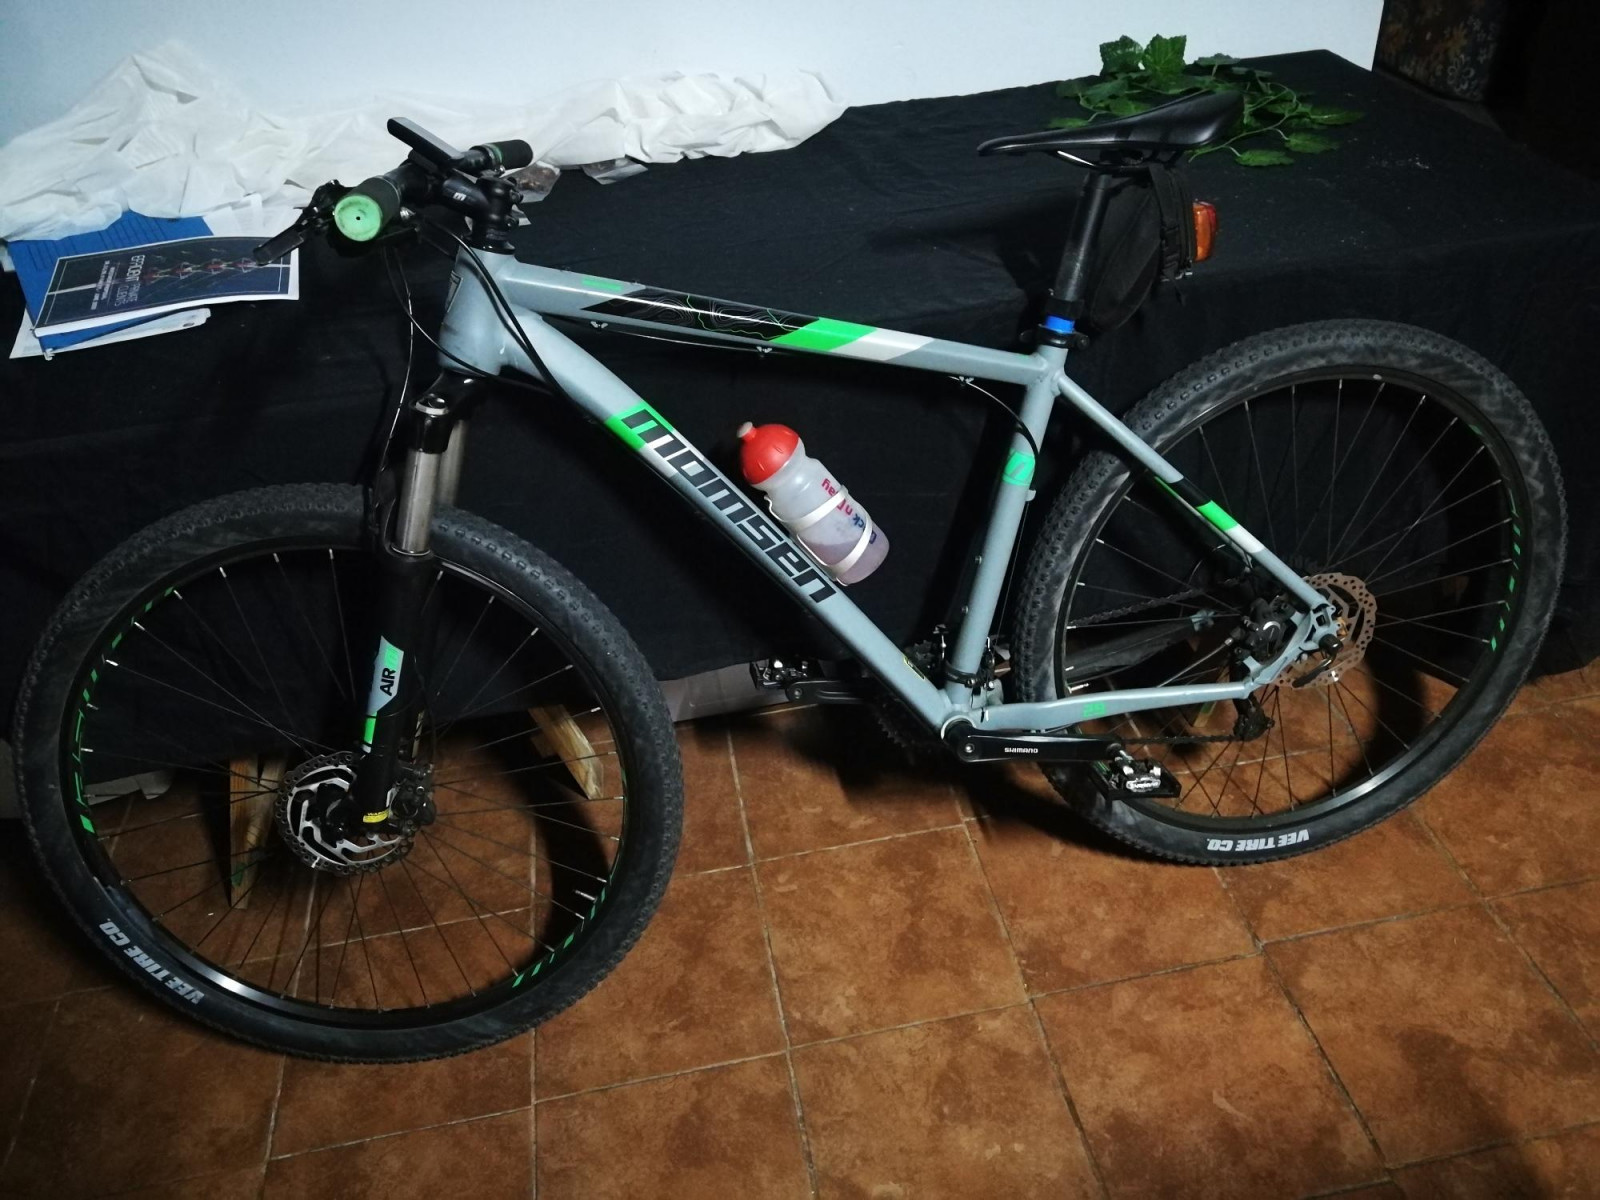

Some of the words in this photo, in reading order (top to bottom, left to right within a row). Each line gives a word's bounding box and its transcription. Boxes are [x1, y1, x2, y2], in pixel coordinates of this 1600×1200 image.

[853, 513, 877, 545] Pck
[379, 667, 397, 697] AIR
[1235, 837, 1276, 852] TIRE
[1277, 828, 1310, 847] VEE
[123, 945, 170, 982] TIRE
[164, 976, 205, 1004] VEE
